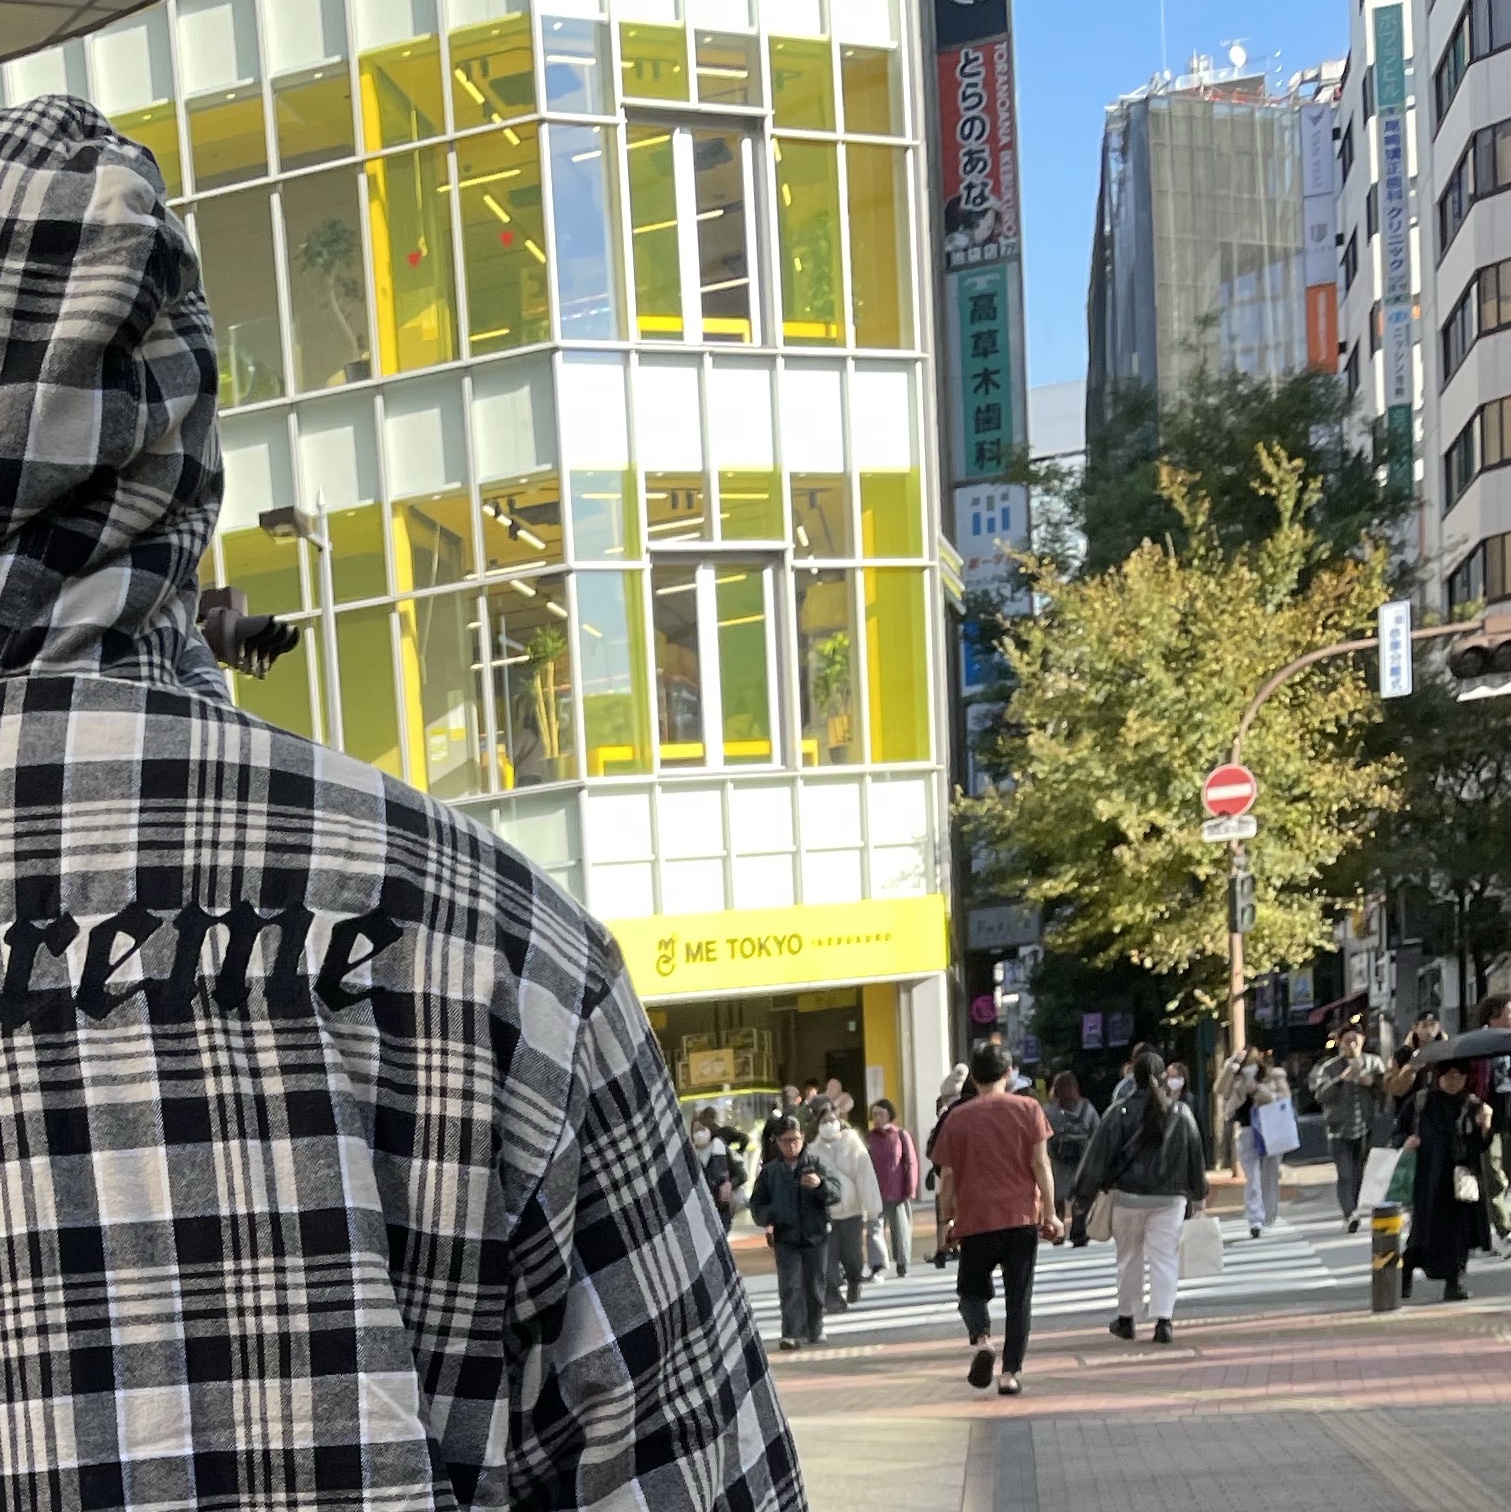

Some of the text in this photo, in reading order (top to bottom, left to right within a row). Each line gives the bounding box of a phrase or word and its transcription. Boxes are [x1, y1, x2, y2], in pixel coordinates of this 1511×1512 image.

[957, 48, 991, 211] とらのあな
[994, 41, 1012, 147] TORANOANA
[968, 291, 1002, 472] 高草木歯科
[685, 940, 717, 964] ME
[726, 933, 803, 959] TOKYO
